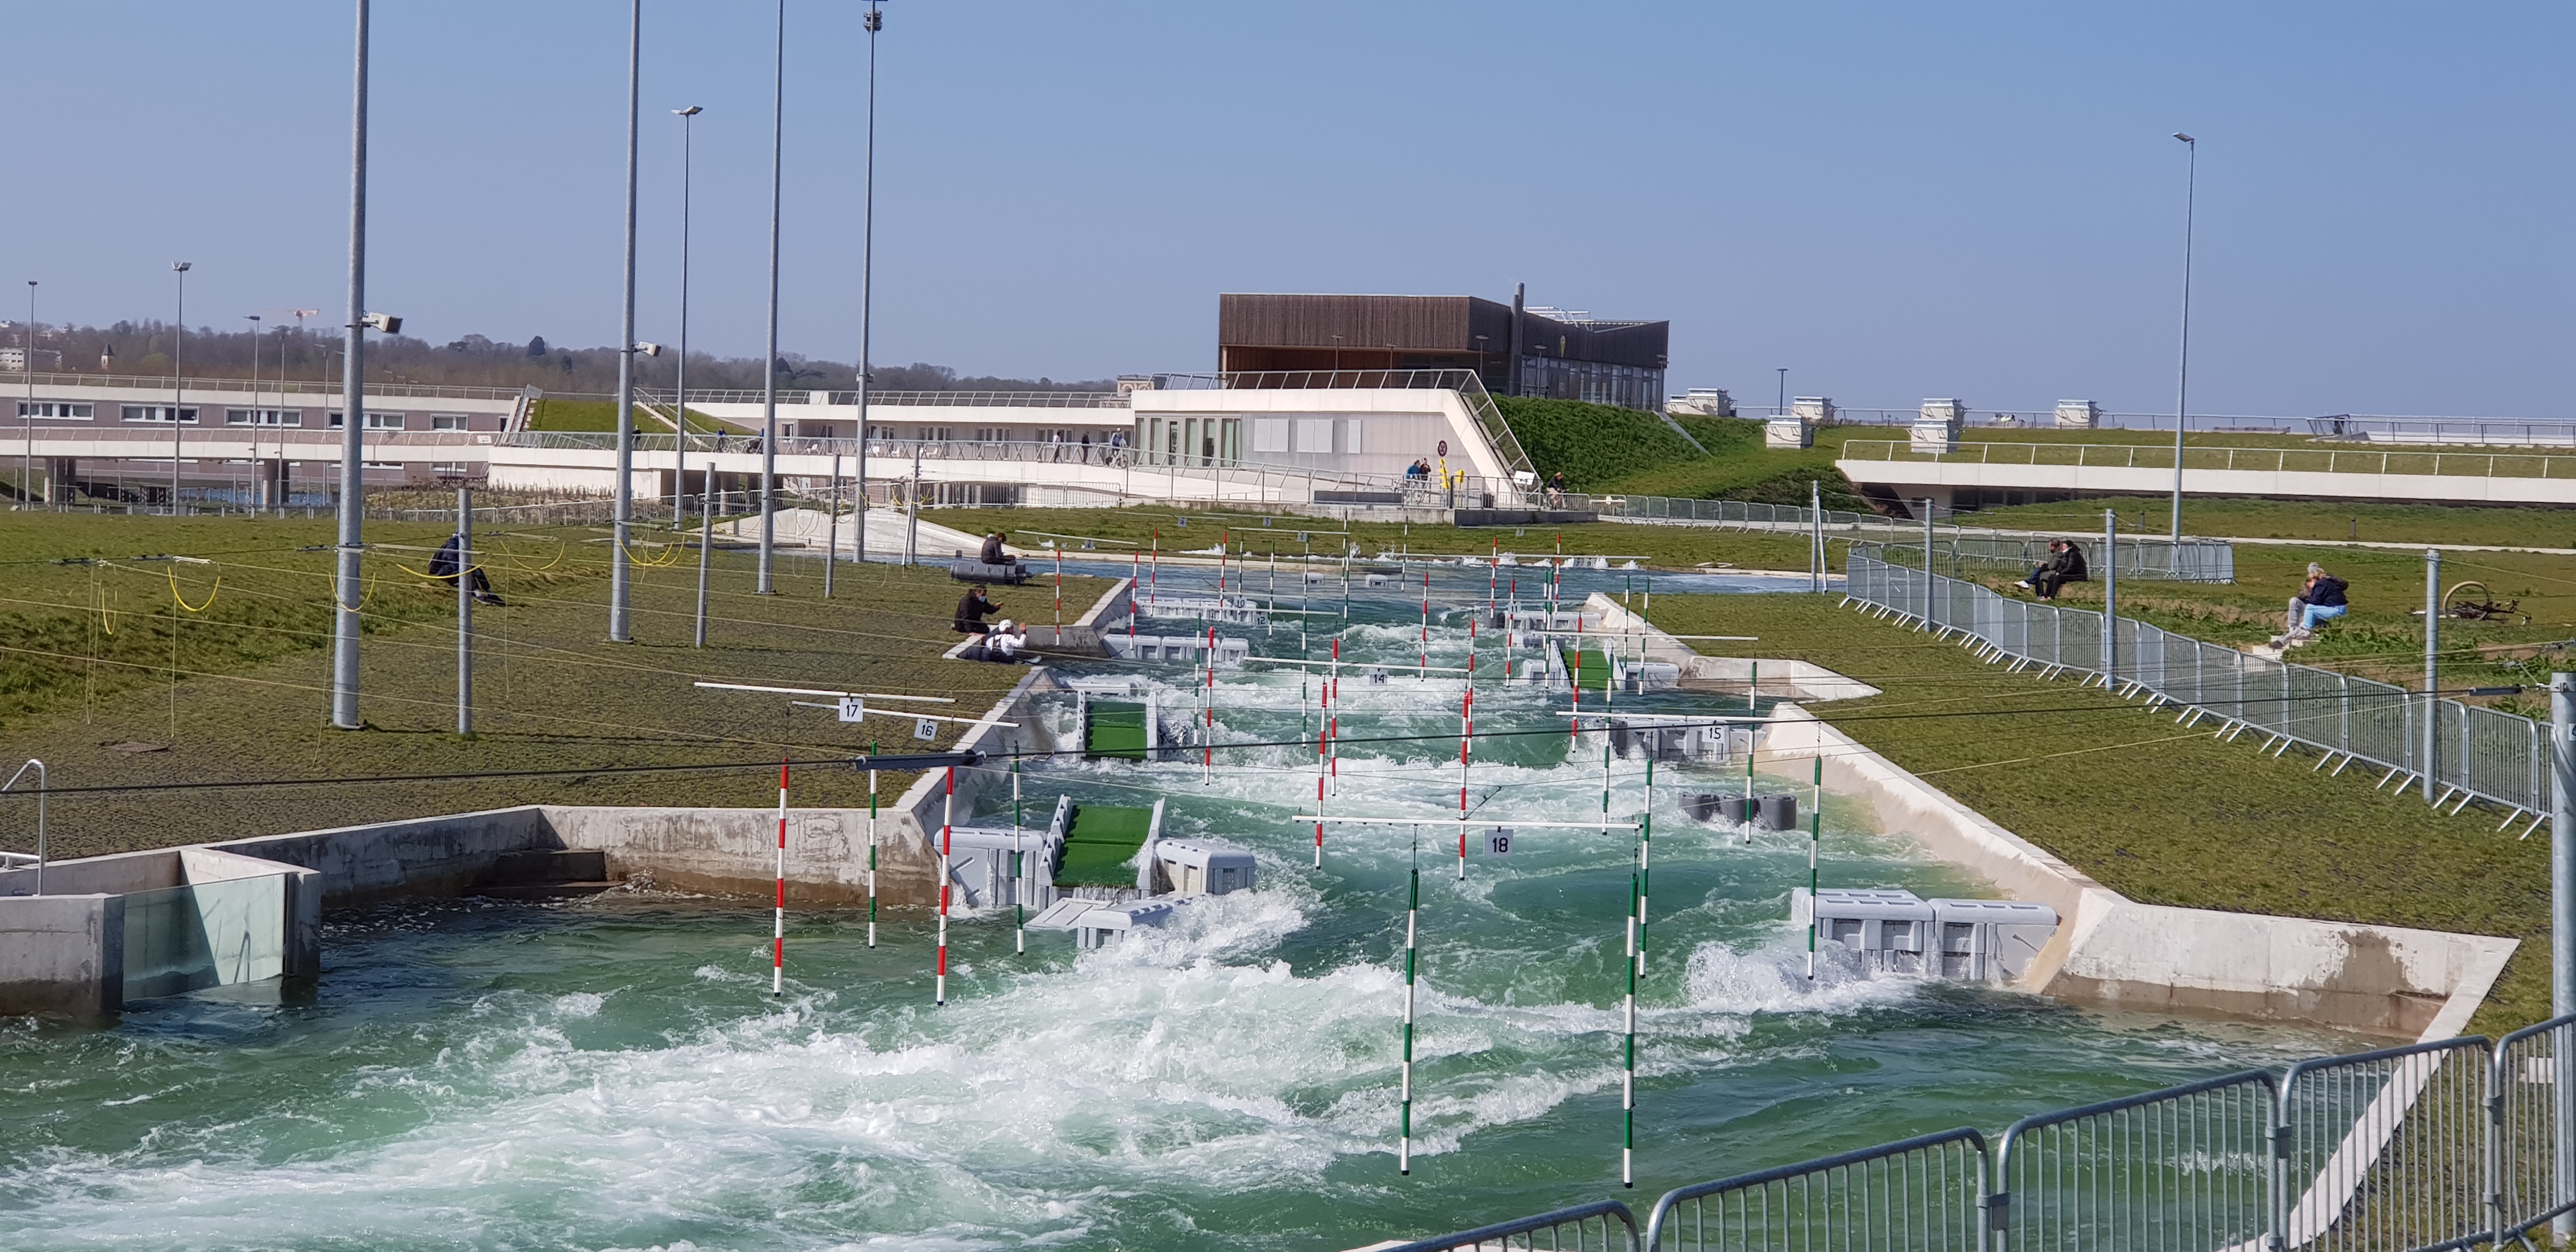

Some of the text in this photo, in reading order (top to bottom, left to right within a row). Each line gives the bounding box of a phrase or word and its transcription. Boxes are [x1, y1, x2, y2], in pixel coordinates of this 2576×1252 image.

[1257, 616, 1265, 625] 12
[1374, 674, 1384, 683] 14
[846, 705, 859, 717] 17
[921, 724, 933, 736] 16
[1710, 728, 1721, 739] 15
[1492, 837, 1508, 853] 18
